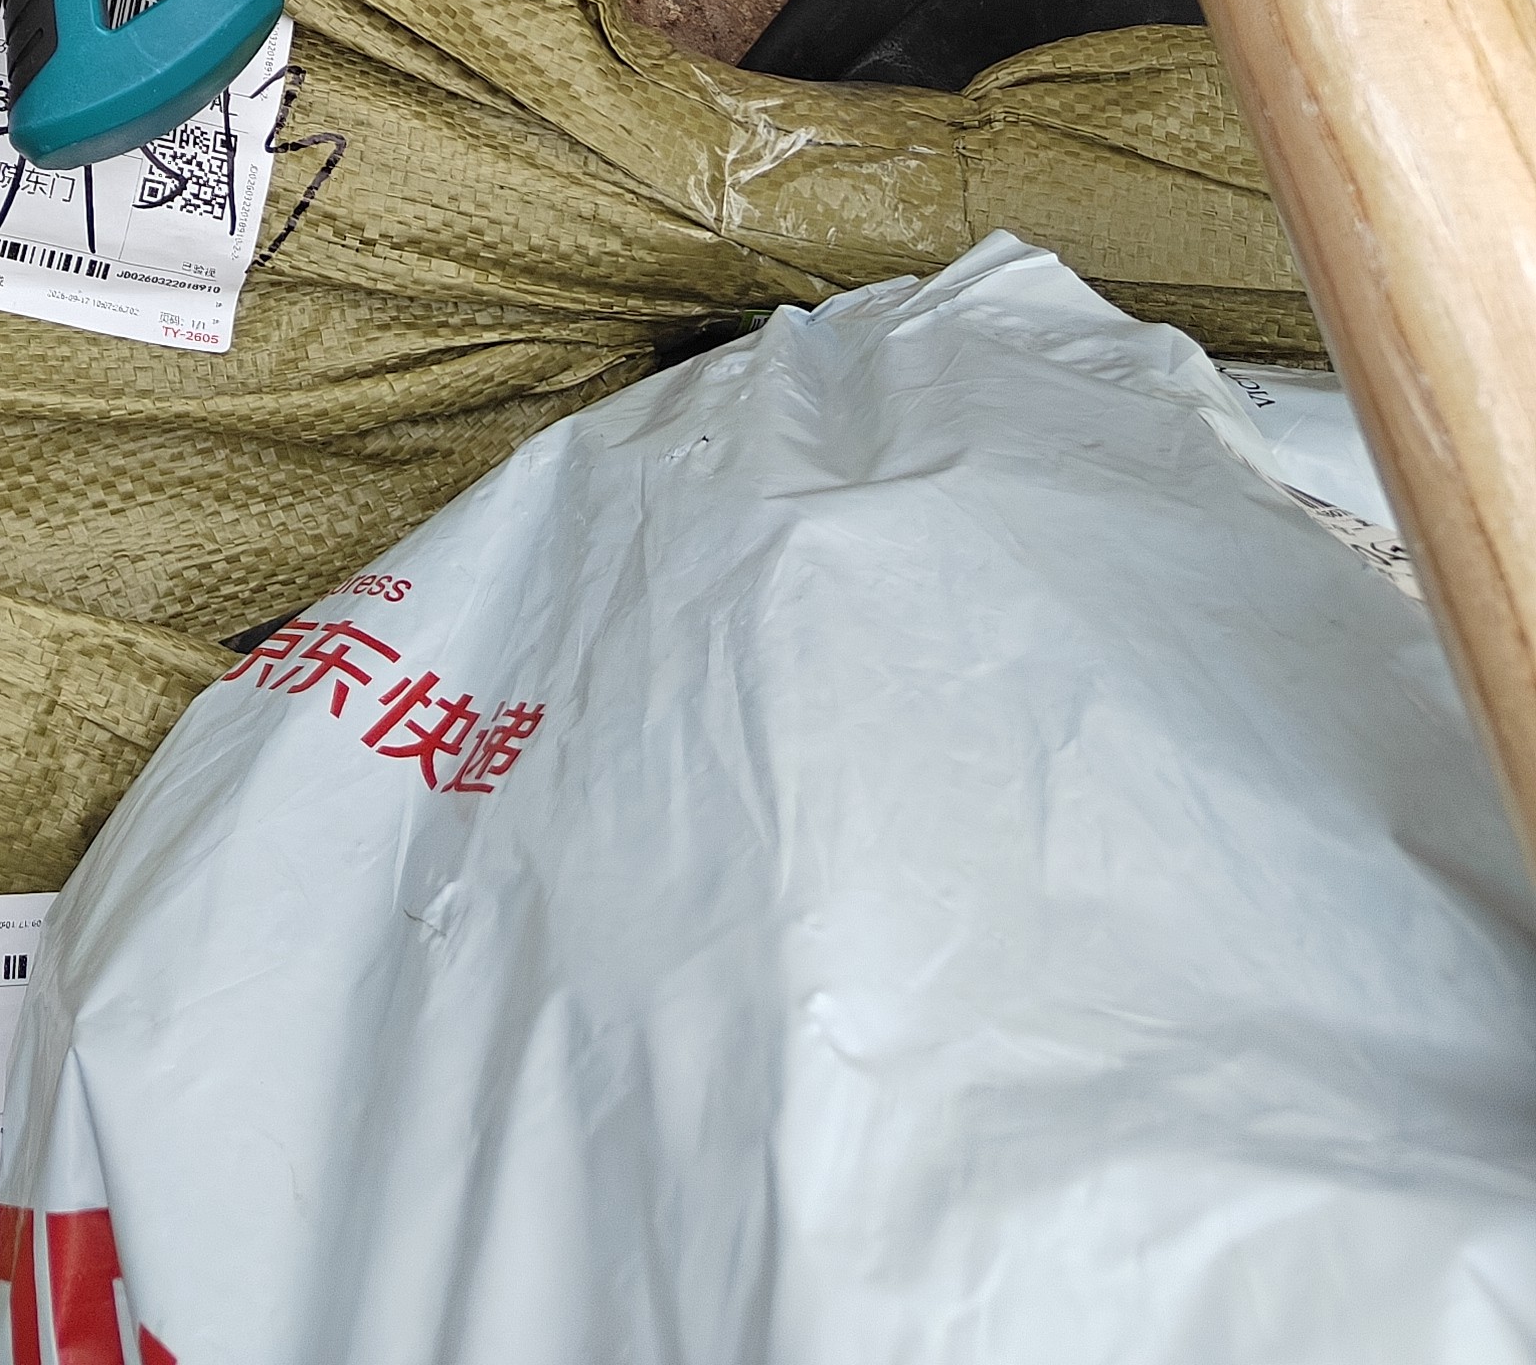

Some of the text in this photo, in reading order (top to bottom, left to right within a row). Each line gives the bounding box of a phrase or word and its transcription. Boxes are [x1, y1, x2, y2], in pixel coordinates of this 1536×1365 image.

[160, 325, 220, 345] TY-2605
[220, 617, 546, 795] 京东快递
